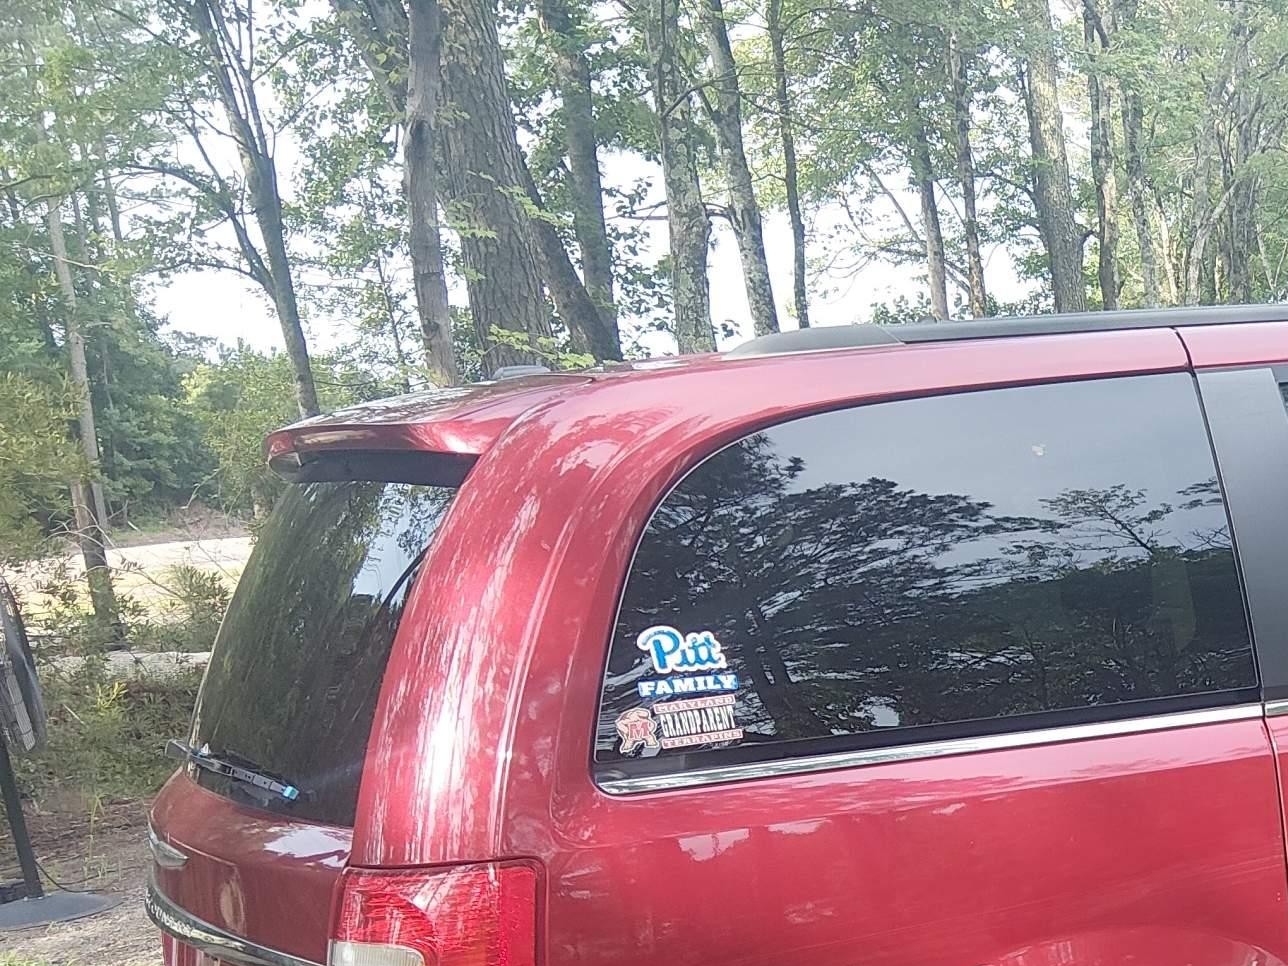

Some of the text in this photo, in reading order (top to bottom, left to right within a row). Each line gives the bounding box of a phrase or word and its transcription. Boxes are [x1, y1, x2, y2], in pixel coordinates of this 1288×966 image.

[640, 628, 723, 670] Pitt
[639, 674, 738, 697] FAMILY
[657, 696, 734, 713] MARYLAND
[659, 705, 737, 738] GRANDPARENT
[664, 730, 742, 748] TERRAPINS
